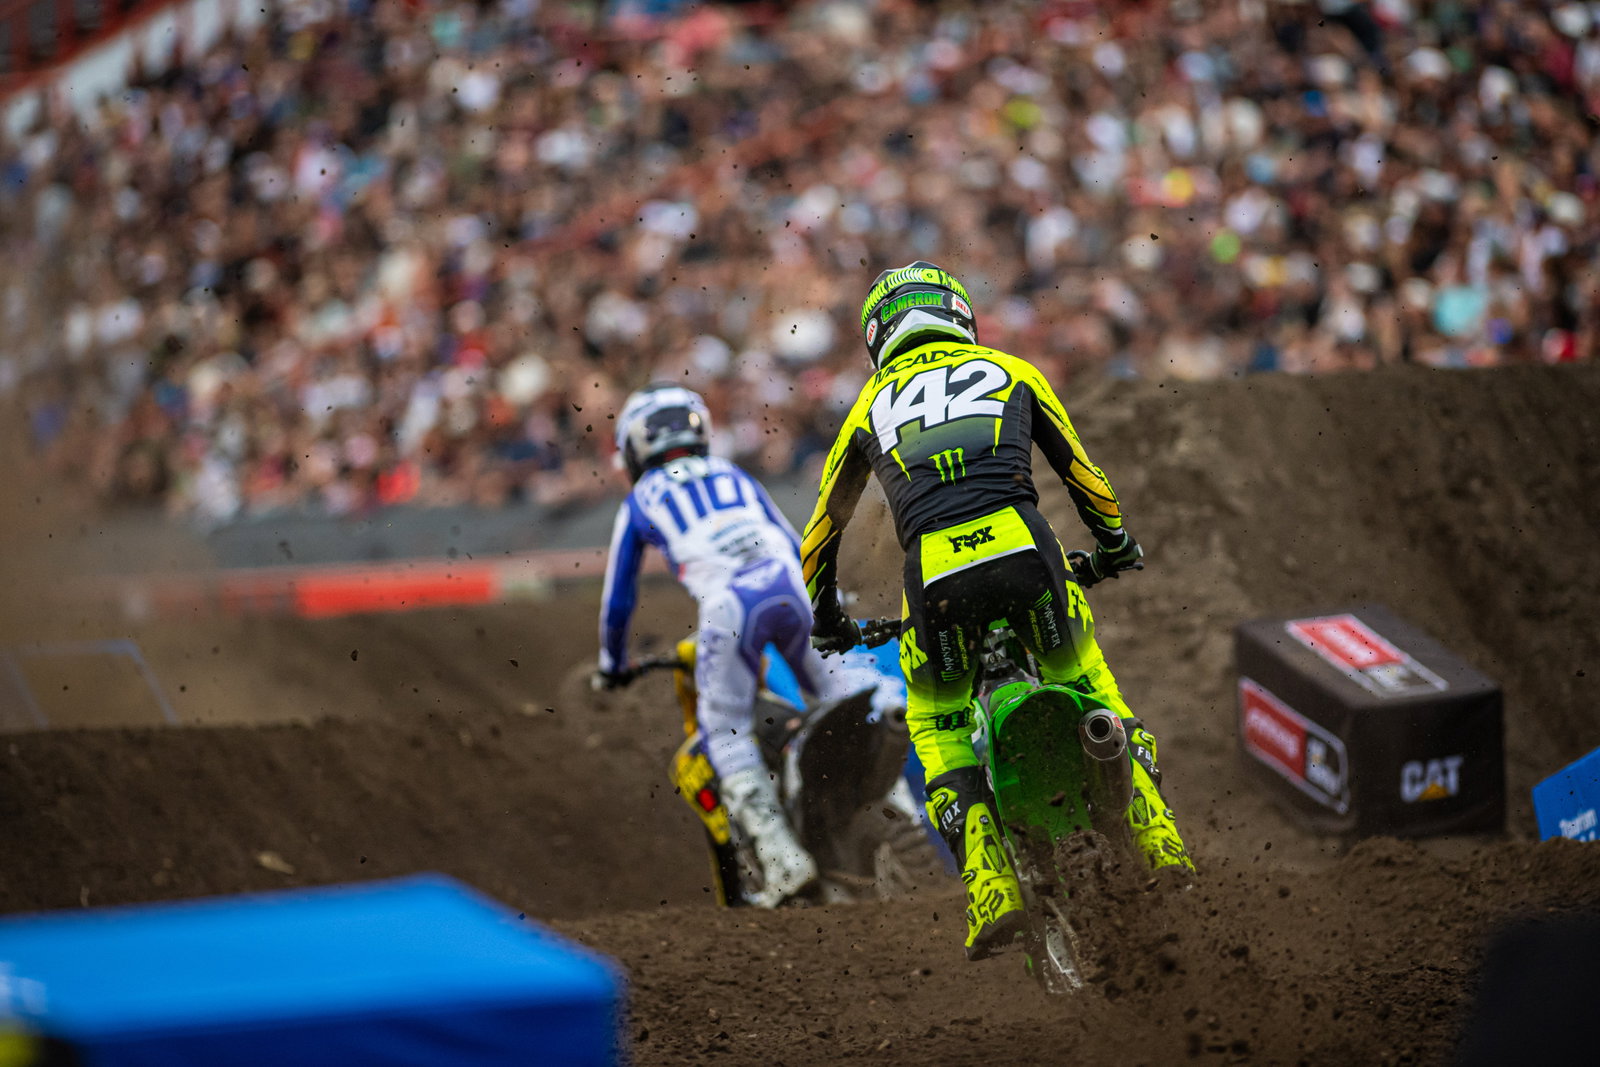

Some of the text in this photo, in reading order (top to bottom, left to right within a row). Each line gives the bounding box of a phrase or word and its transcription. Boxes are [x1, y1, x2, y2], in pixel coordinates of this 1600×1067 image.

[881, 292, 943, 323] CAMERON
[955, 300, 970, 315] BELL
[867, 323, 876, 343] BELL
[868, 359, 1008, 455] 142
[660, 473, 746, 533] 110
[948, 525, 996, 554] FOX
[939, 630, 955, 672] MONSTER
[1401, 756, 1465, 802] CAT
[941, 801, 962, 830] FOX
